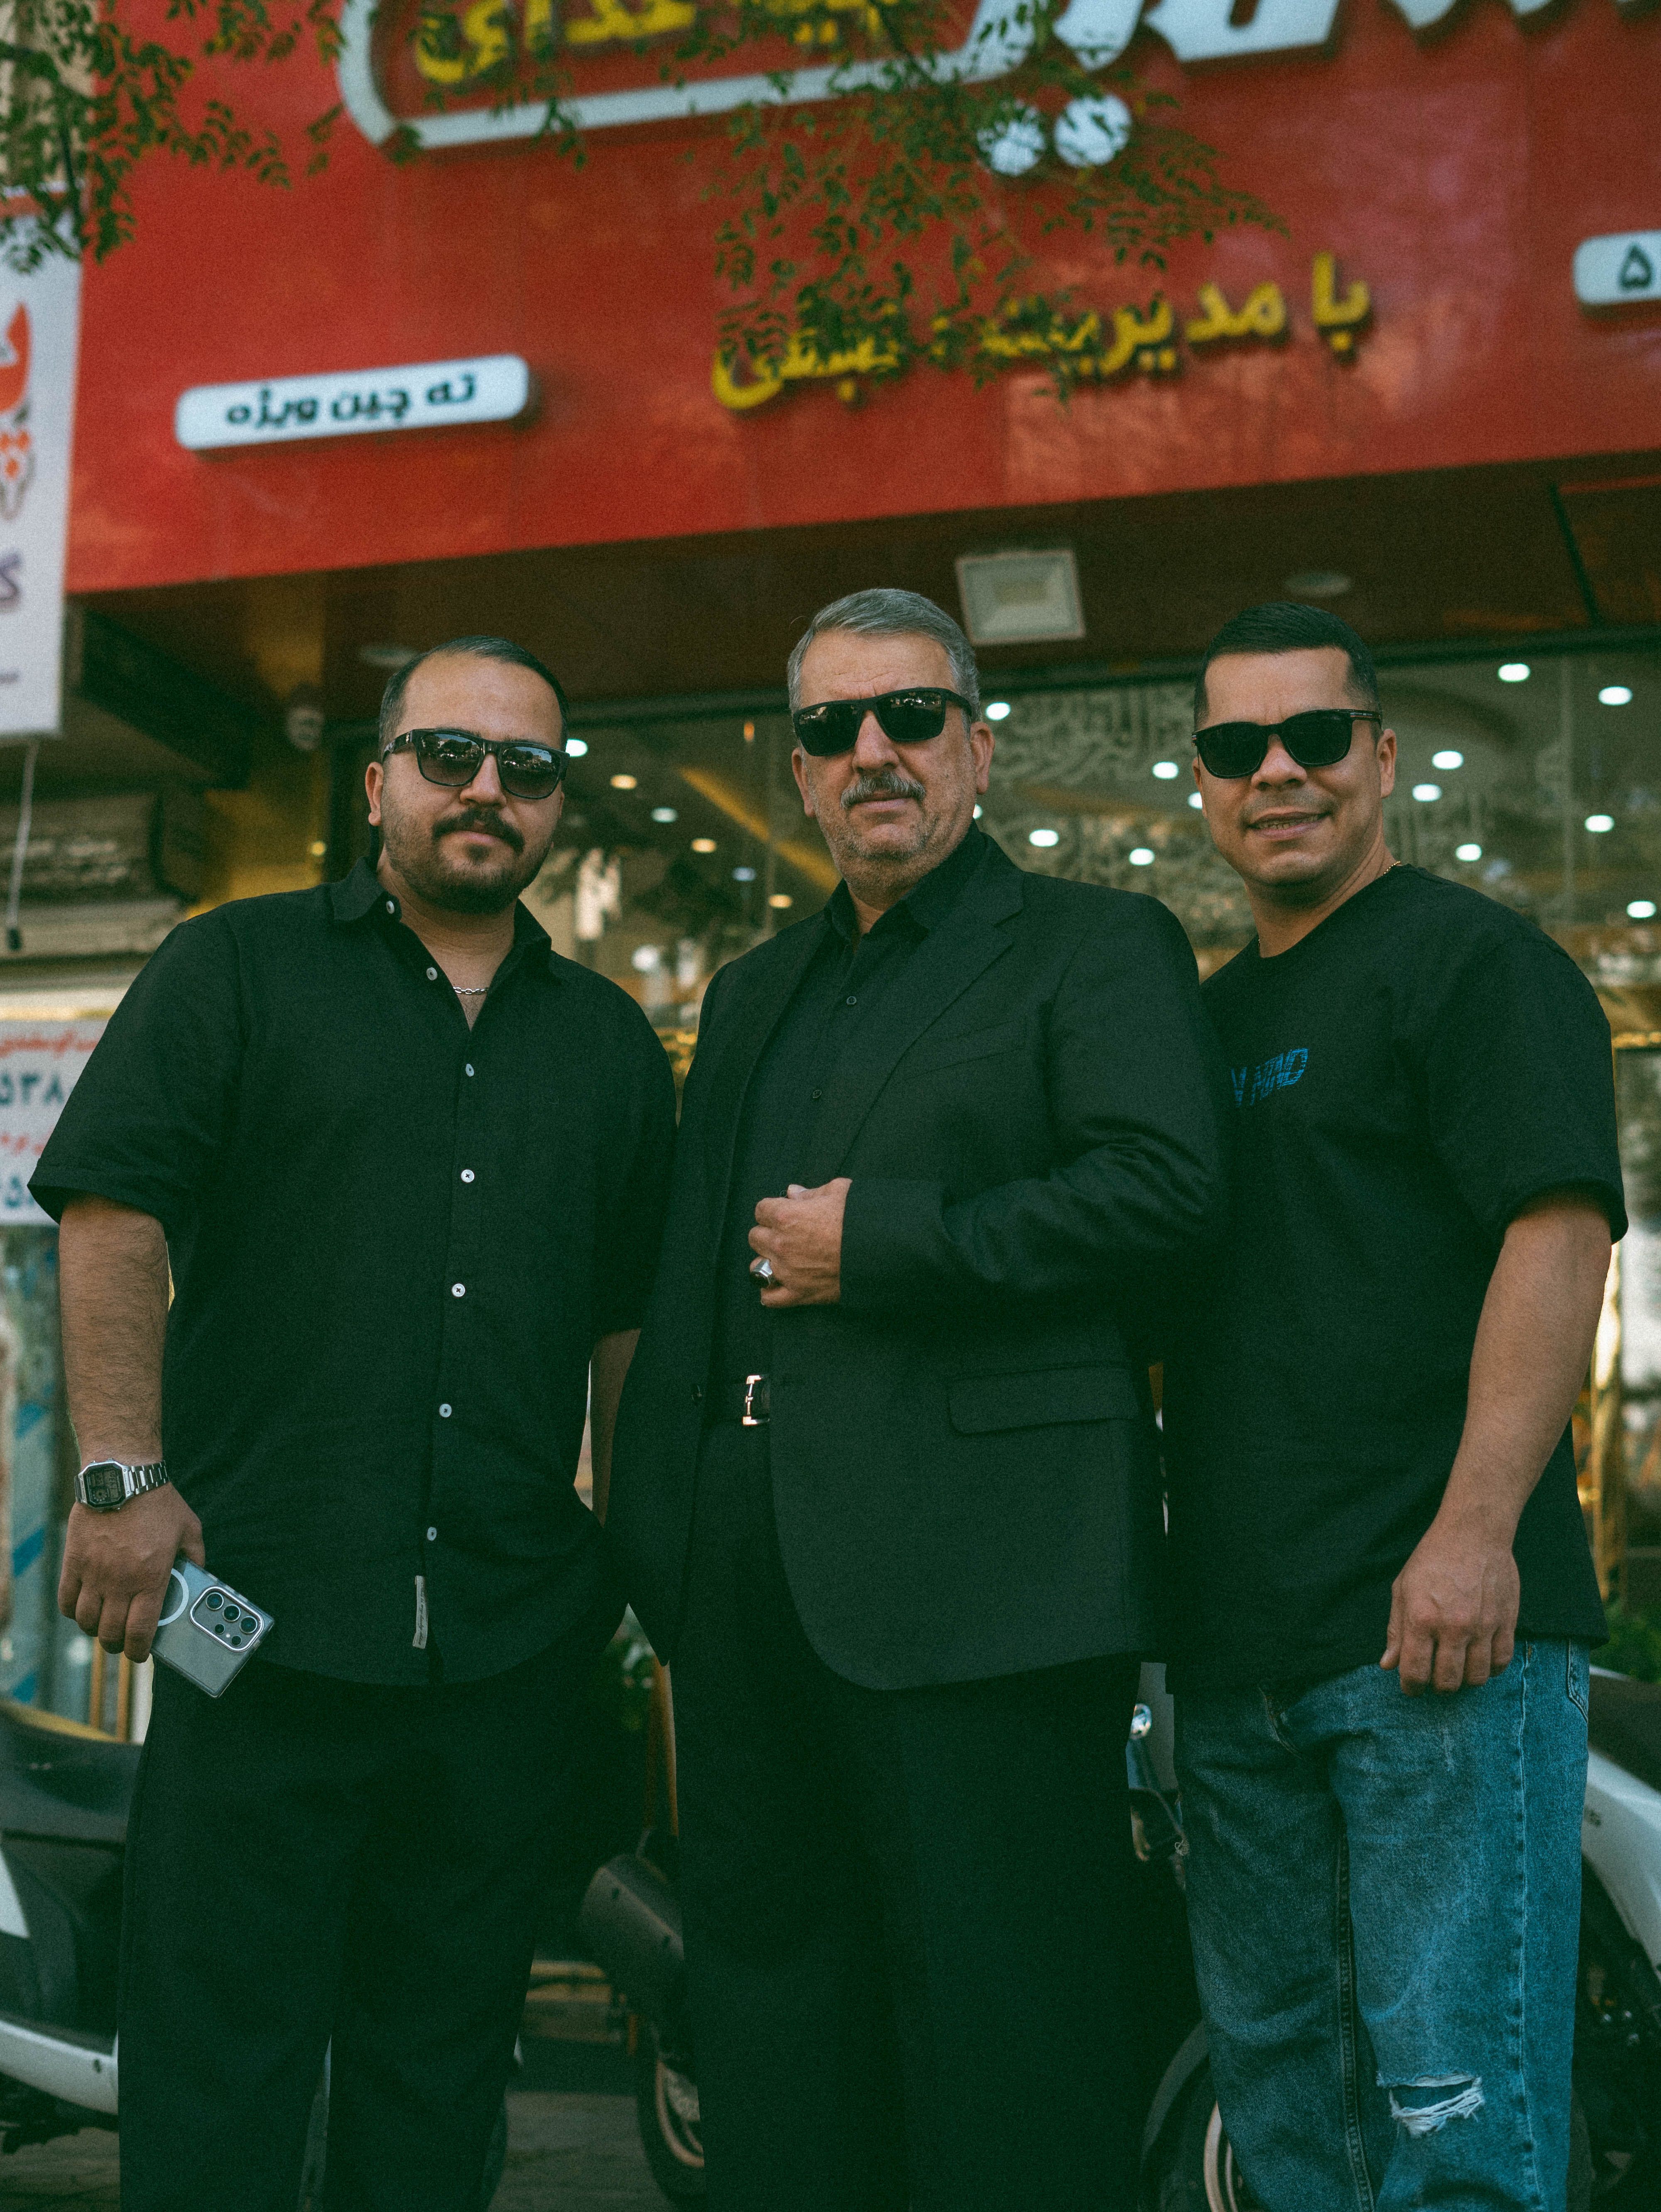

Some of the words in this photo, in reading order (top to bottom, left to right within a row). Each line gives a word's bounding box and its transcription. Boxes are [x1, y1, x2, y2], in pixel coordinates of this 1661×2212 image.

[1311, 252, 1371, 352] با
[226, 386, 320, 431] ویژه
[426, 372, 477, 406] ته
